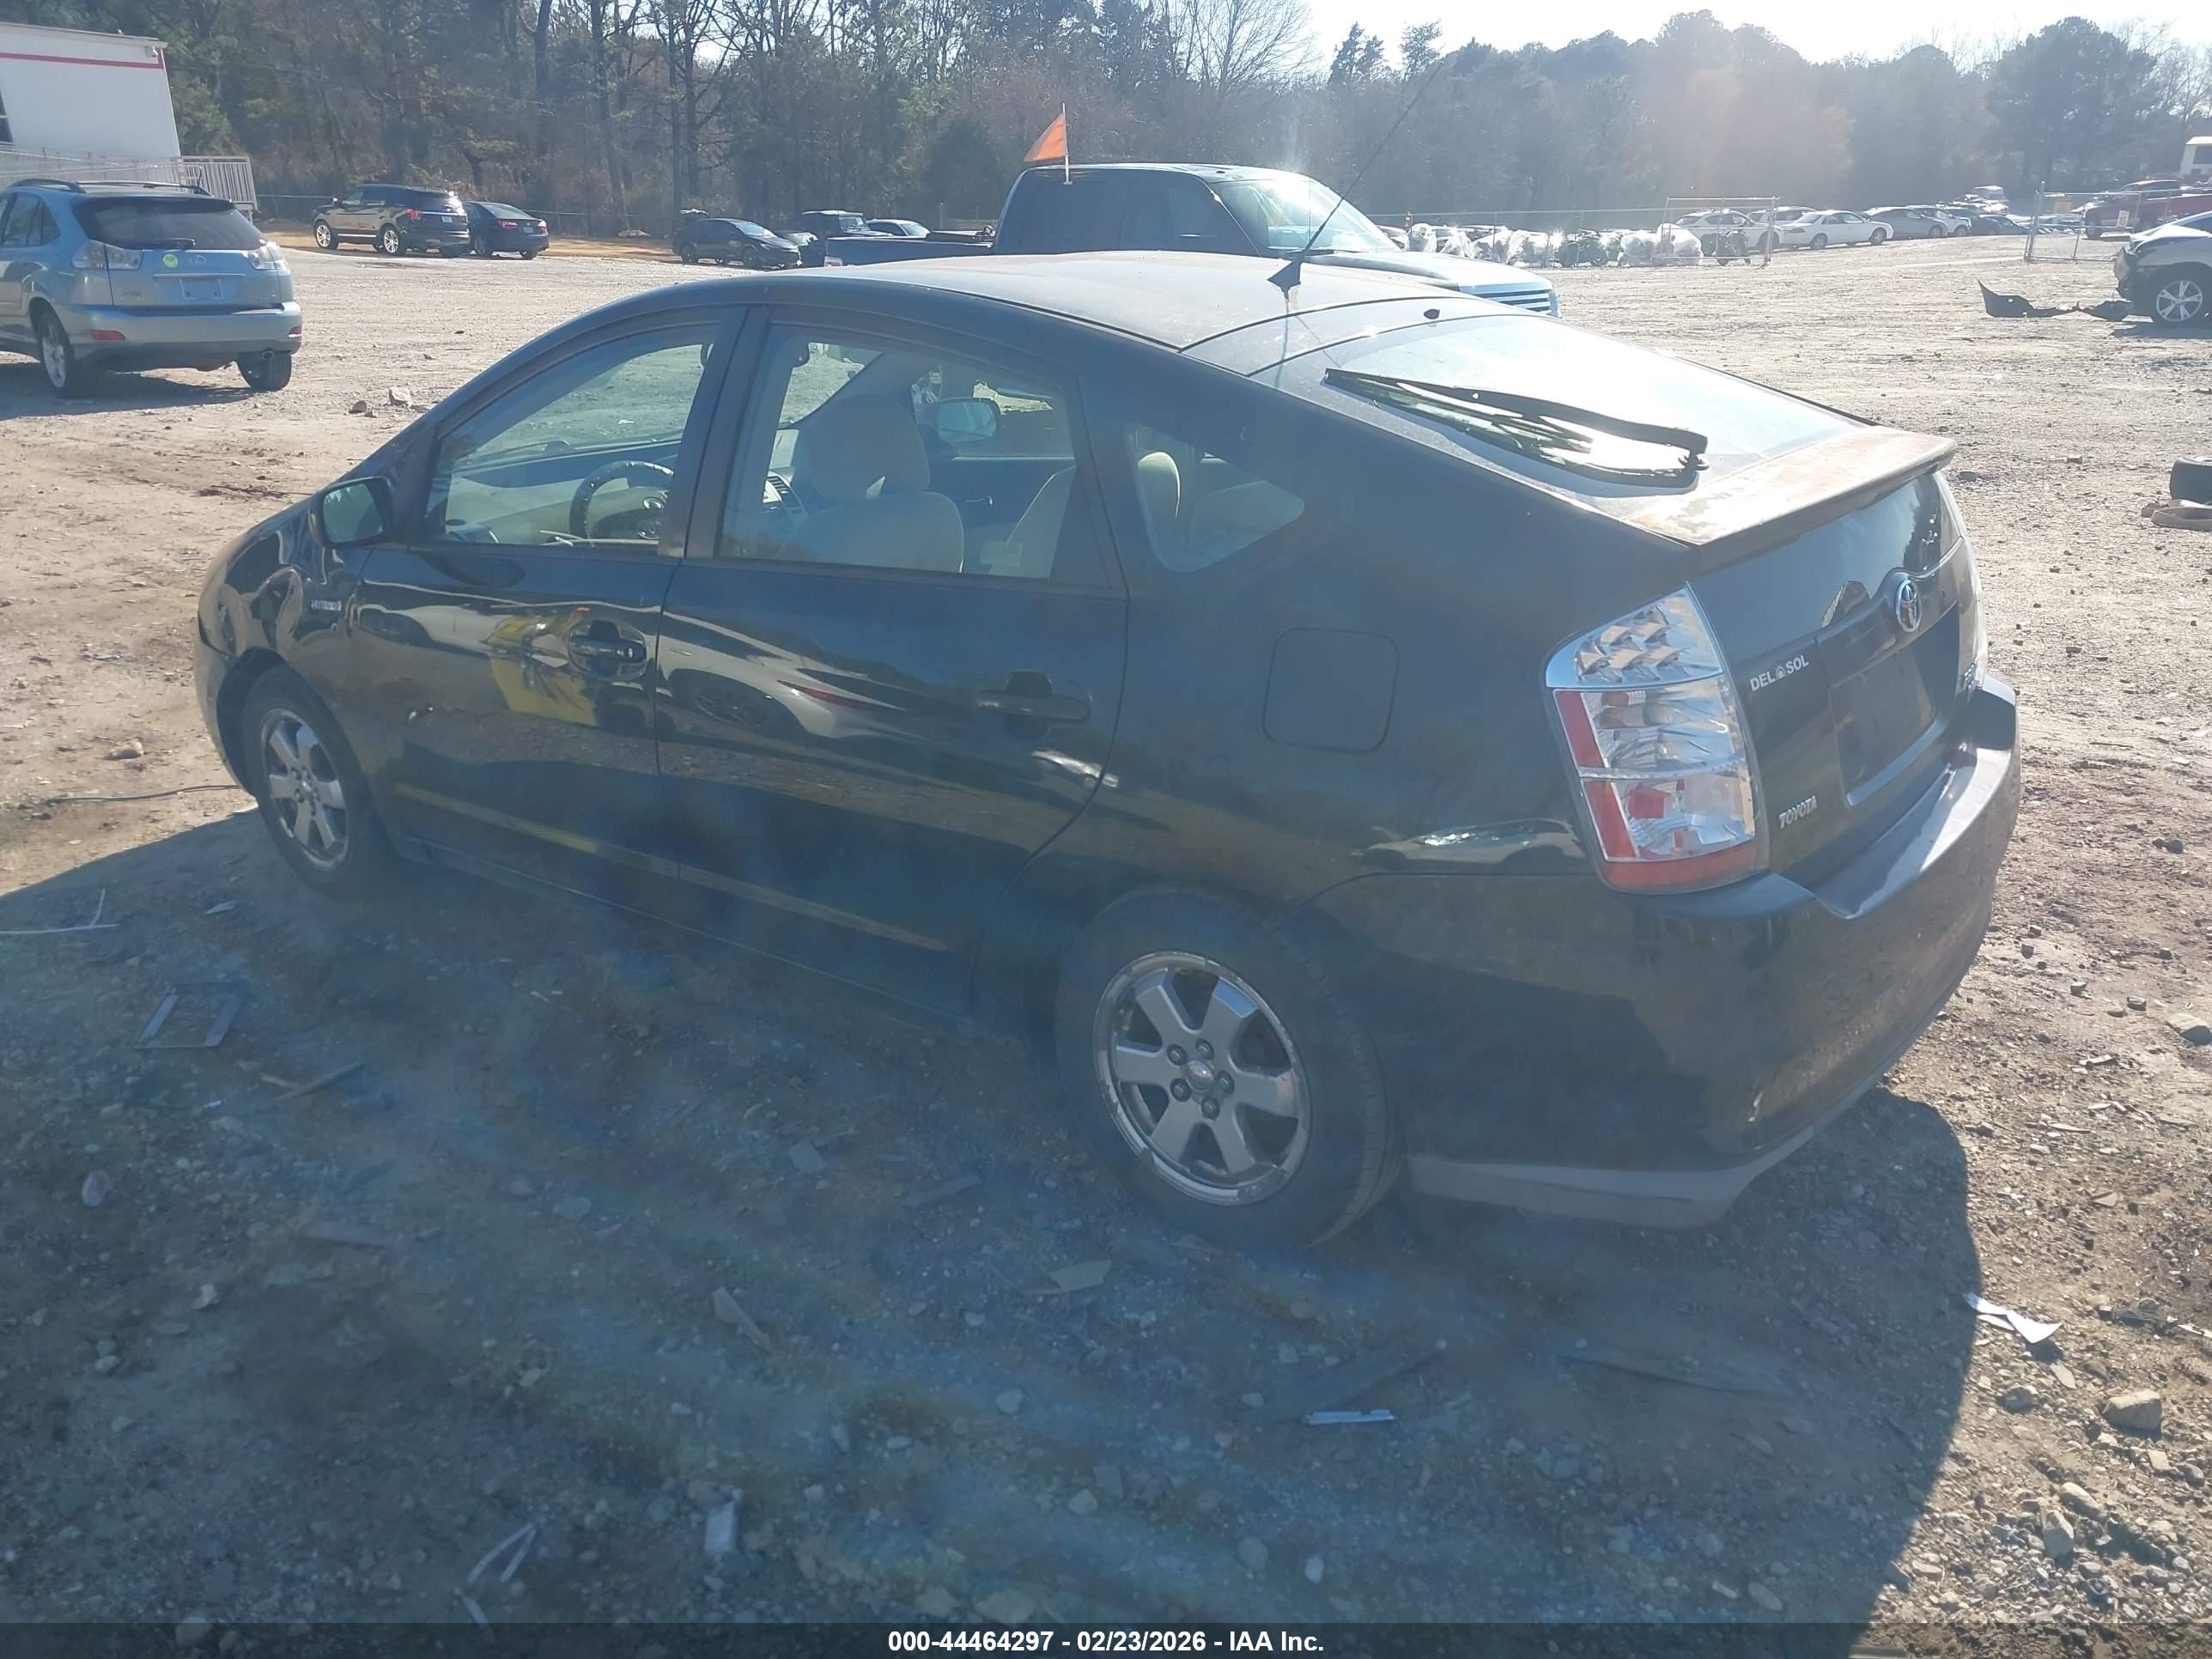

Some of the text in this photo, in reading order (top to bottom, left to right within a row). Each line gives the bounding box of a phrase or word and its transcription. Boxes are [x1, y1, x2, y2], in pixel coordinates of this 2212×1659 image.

[1750, 654, 1809, 692] DEL SOL
[1778, 795, 1818, 830] TOYOTA
